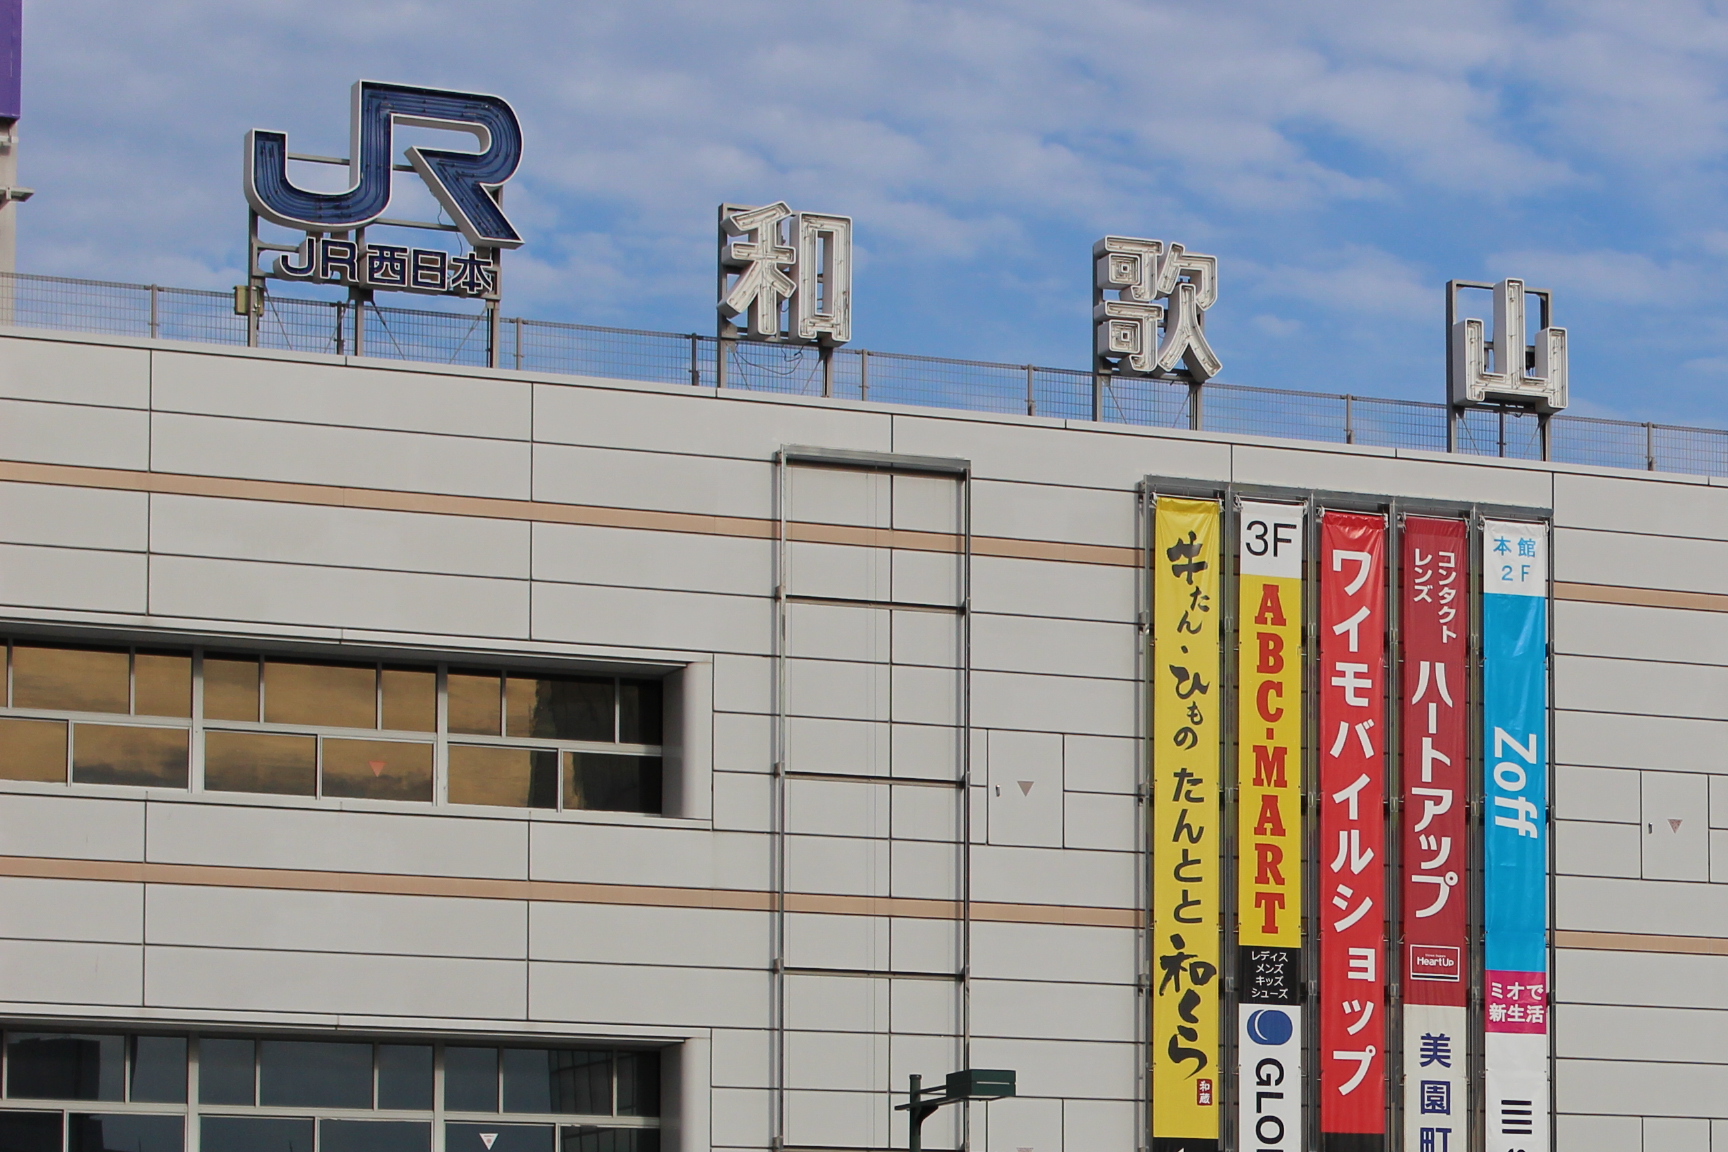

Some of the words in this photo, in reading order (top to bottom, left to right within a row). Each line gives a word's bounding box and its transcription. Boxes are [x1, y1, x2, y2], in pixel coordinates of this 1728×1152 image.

[244, 79, 525, 250] JR
[274, 236, 496, 296] JR西日本
[1245, 519, 1298, 558] 3F
[1493, 537, 1536, 557] 本館
[1413, 548, 1433, 604] レンズ
[1438, 551, 1457, 644] コンタクト
[1411, 661, 1458, 918] ハートアップ
[1494, 726, 1538, 839] Zoff
[1330, 549, 1377, 1096] ワイモバイルショップ
[1251, 950, 1289, 963] レディス
[1255, 963, 1285, 974] メンズ
[1251, 987, 1289, 1000] シューズ
[1255, 975, 1285, 987] キッズ
[1490, 981, 1544, 1001] ミオで
[1488, 1002, 1545, 1025] 新生活
